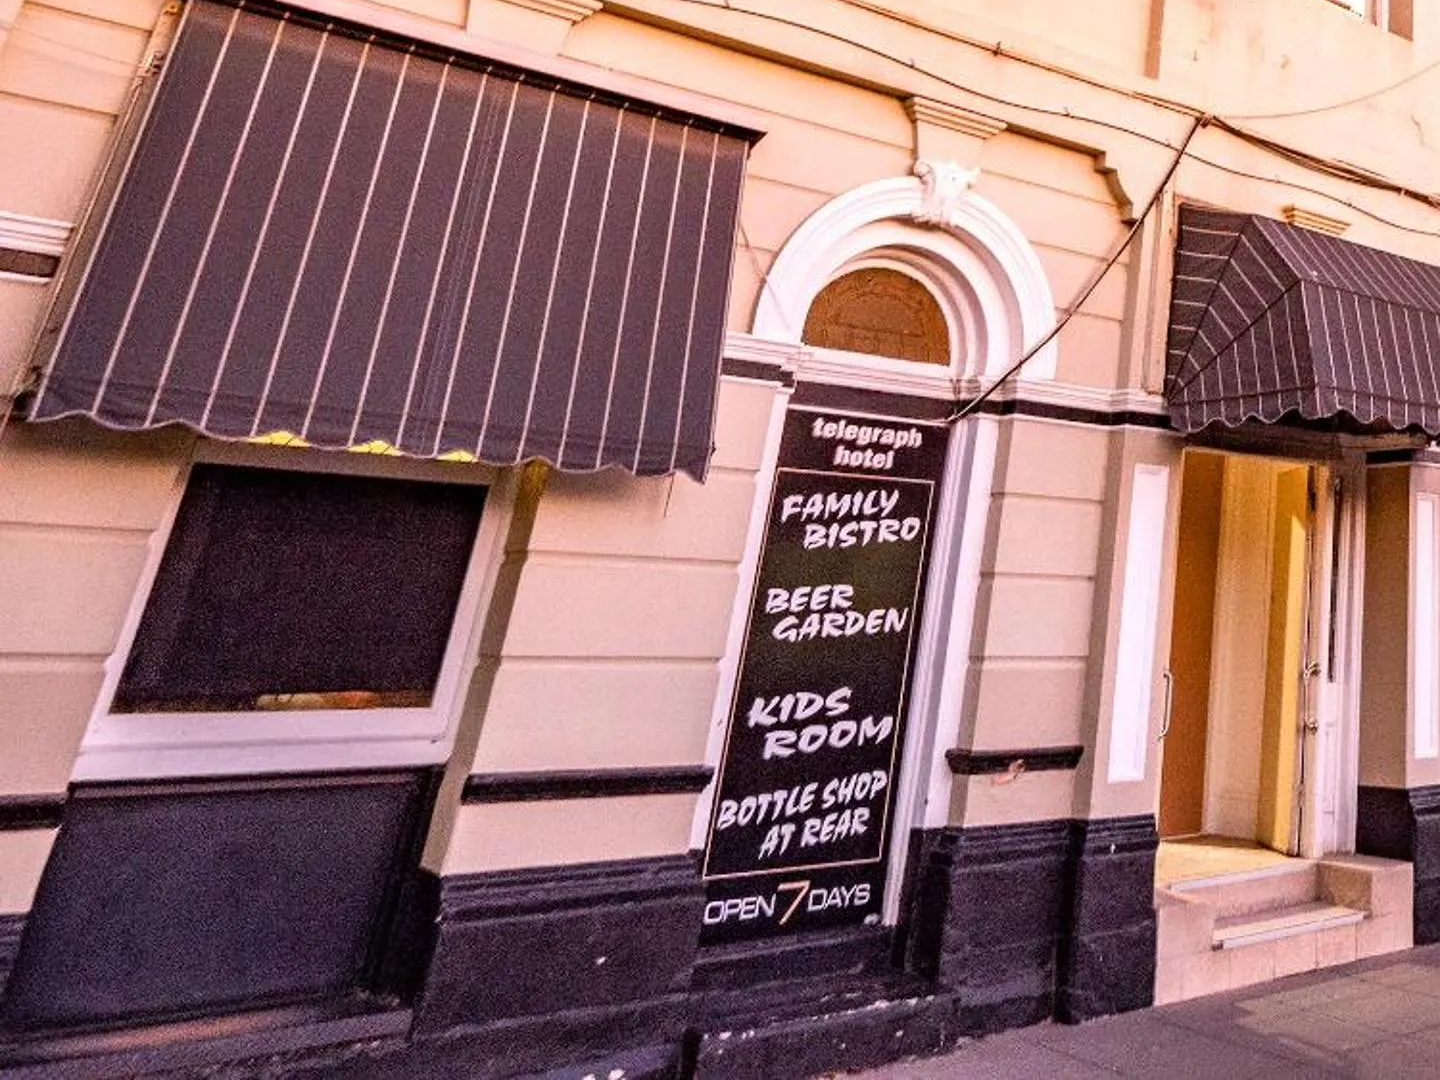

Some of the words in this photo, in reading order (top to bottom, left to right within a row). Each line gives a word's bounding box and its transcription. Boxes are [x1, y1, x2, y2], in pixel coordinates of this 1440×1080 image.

[811, 417, 923, 449] telegraph
[832, 445, 895, 470] hotel
[781, 489, 900, 523] FAMILY
[803, 517, 921, 549] BISTRO
[765, 584, 854, 614] BEER
[772, 607, 909, 643] GARDEN
[747, 686, 853, 728] KIDS
[763, 716, 894, 760] ROOM
[716, 782, 819, 830] BOTTLE
[821, 770, 888, 810] SHOP
[758, 822, 796, 860] AT
[801, 806, 871, 848] REAR
[703, 893, 777, 925] OPEN
[776, 879, 811, 926] 7
[807, 883, 871, 913] DAYS
